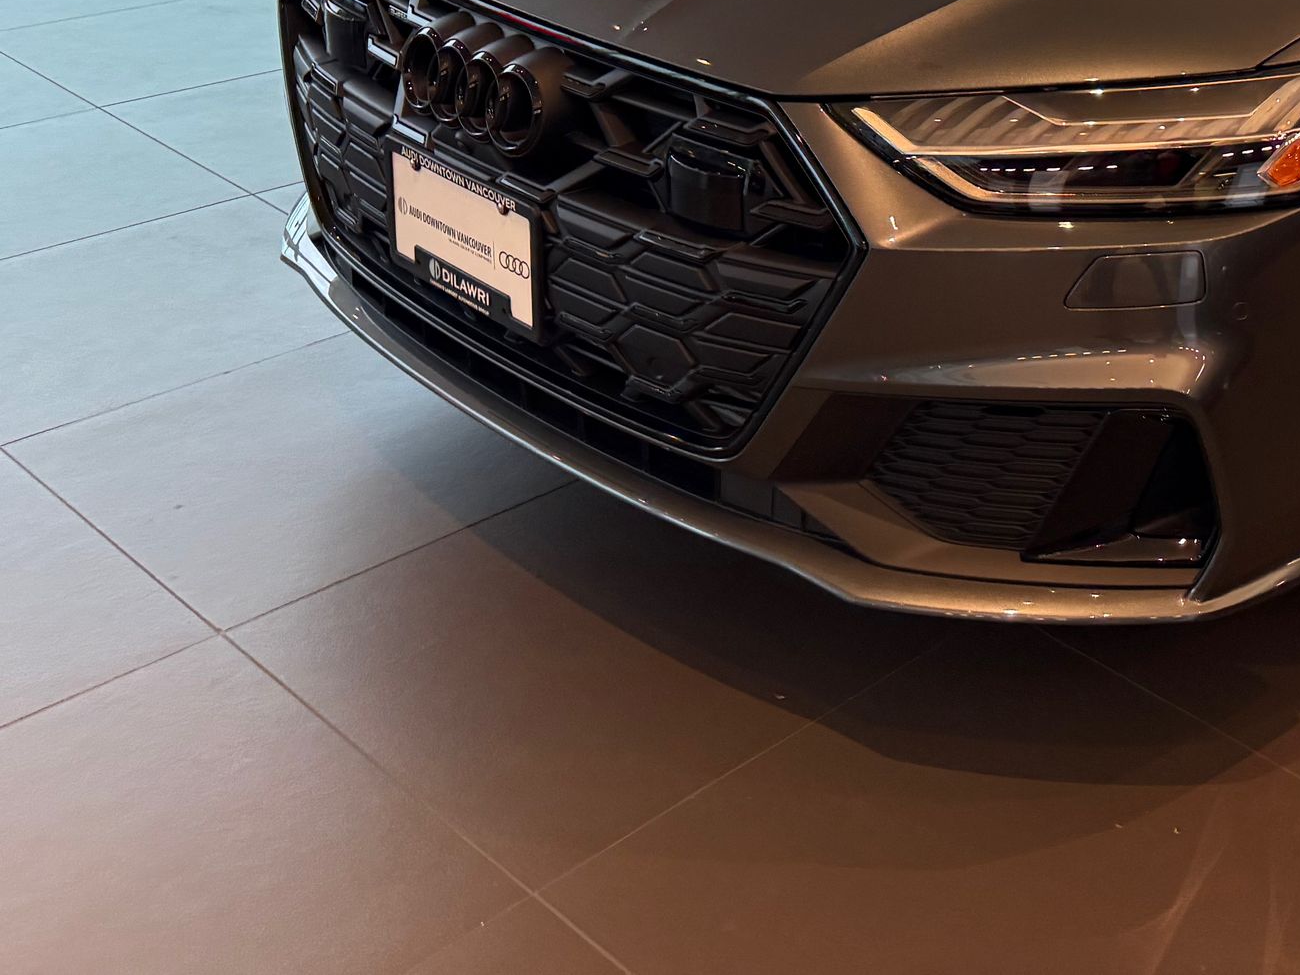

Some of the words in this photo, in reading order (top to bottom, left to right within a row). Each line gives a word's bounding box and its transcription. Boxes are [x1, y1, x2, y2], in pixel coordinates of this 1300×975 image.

[419, 155, 465, 187] DOWNTOWN
[465, 178, 516, 212] VANCOUVER
[409, 205, 422, 221] AUDI
[422, 212, 456, 239] DOWNTOWN
[456, 230, 492, 258] VANCOUVER
[441, 267, 490, 307] DILAWRI
